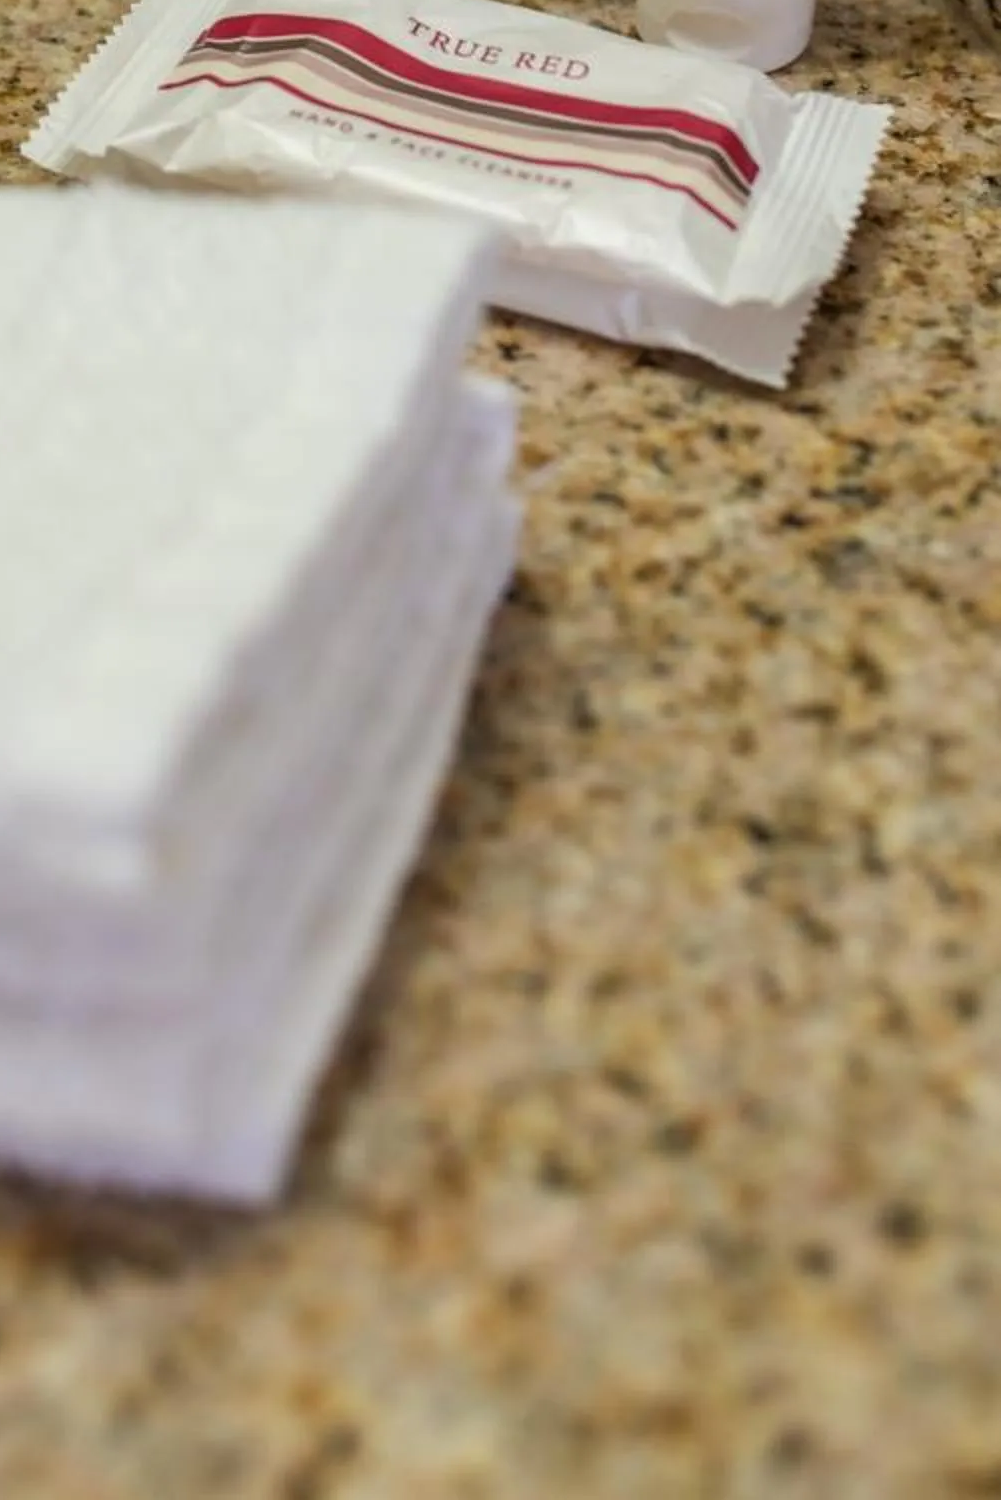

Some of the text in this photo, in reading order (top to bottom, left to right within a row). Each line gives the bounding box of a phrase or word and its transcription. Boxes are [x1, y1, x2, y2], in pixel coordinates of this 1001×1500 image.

[406, 16, 592, 81] TRUE RED
[288, 108, 354, 134] HAND
[390, 137, 447, 160] FACE
